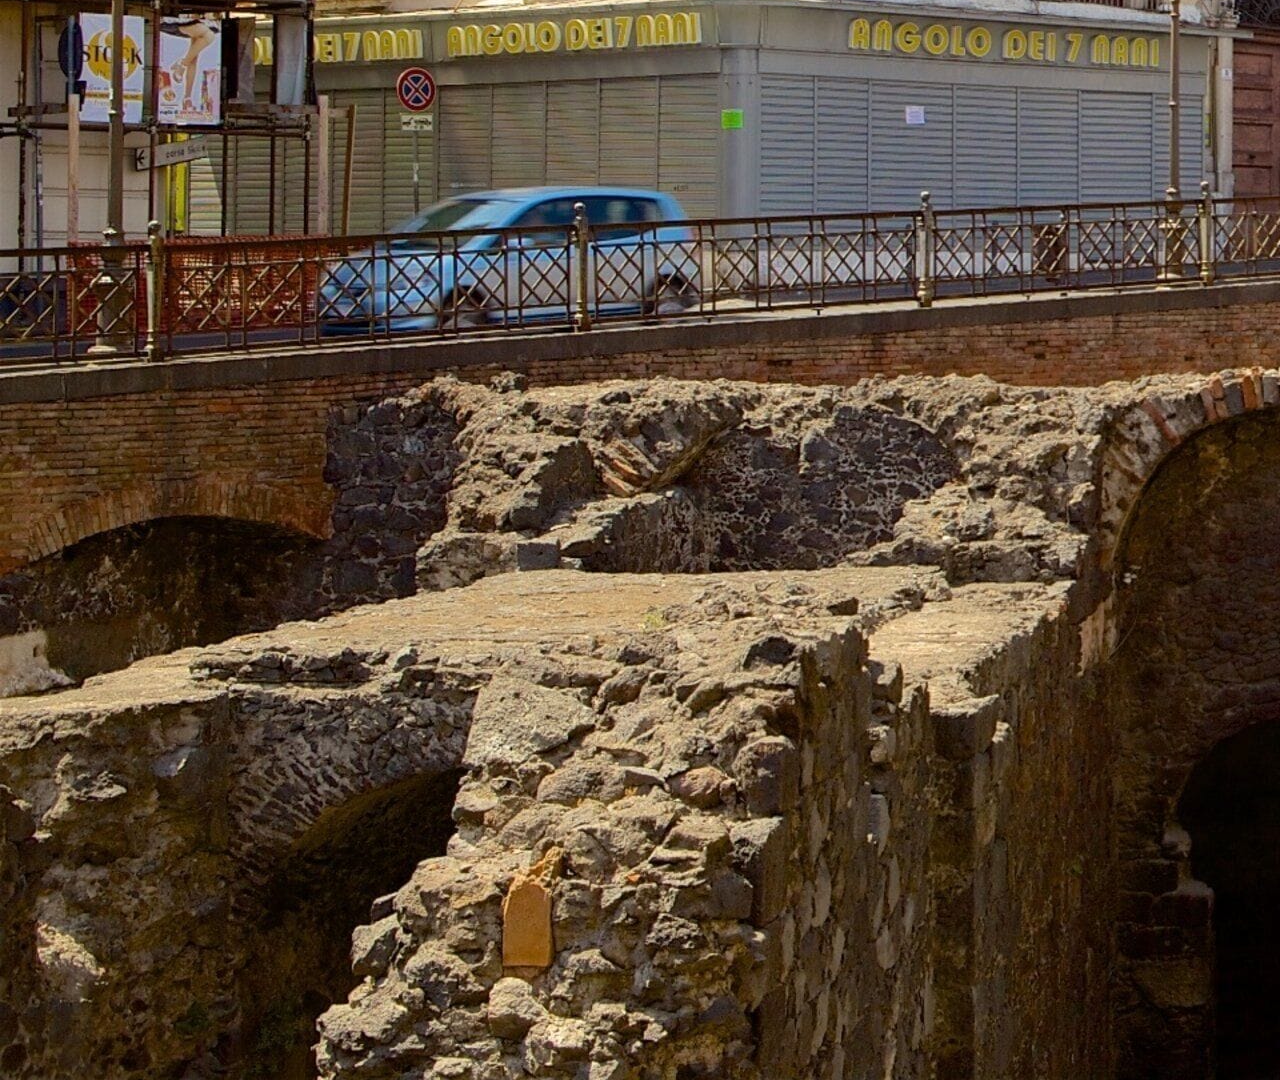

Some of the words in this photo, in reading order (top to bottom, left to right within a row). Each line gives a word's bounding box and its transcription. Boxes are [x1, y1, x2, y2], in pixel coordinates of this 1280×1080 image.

[343, 32, 360, 62] 7
[362, 29, 423, 61] NANI
[447, 21, 561, 57] ANGOLO
[565, 18, 613, 51] DEI
[615, 16, 633, 48] 7
[635, 12, 702, 47] NANI
[848, 18, 992, 58] ANGOLO
[1002, 29, 1057, 62] DEI
[1065, 33, 1083, 63] 7
[1092, 34, 1160, 67] NANI
